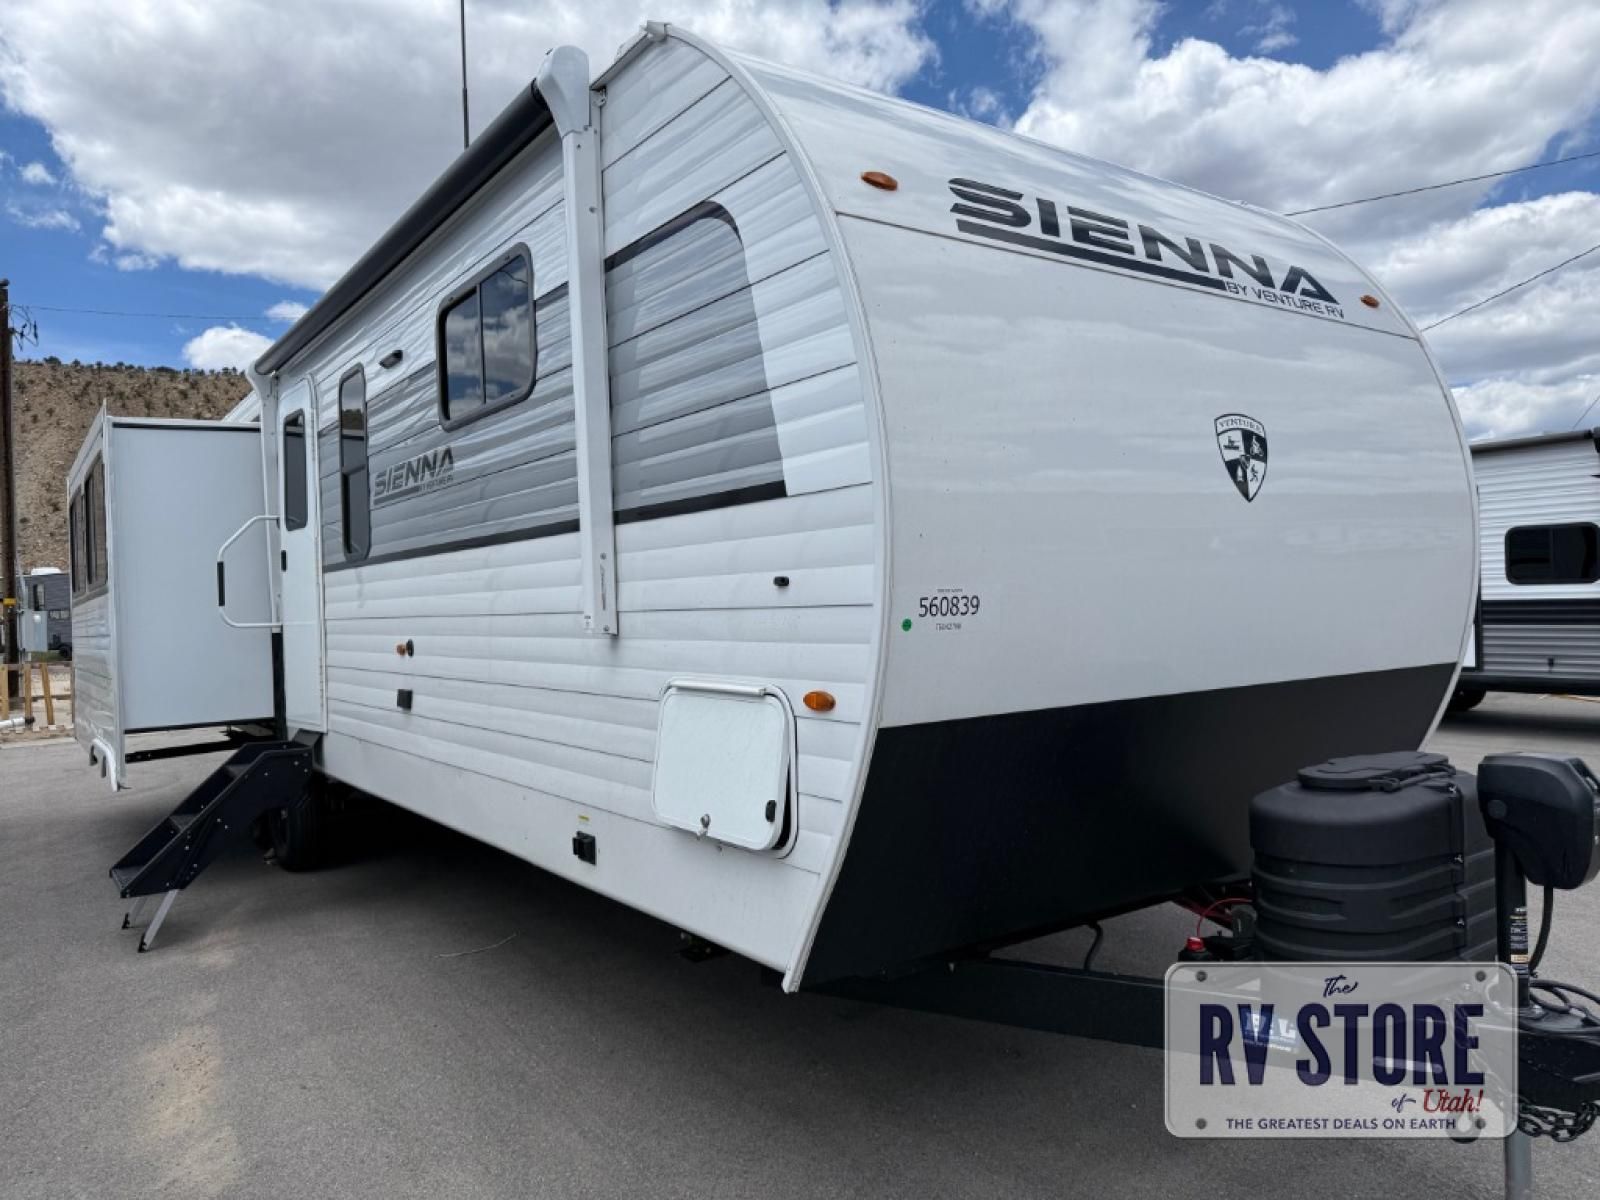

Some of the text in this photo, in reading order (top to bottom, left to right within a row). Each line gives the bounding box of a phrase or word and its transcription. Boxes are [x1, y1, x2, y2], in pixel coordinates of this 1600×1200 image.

[948, 177, 1340, 304] SIENNA
[1226, 281, 1345, 319] BY VENTURE RV
[374, 446, 454, 497] SIENNA
[918, 595, 981, 618] 560839
